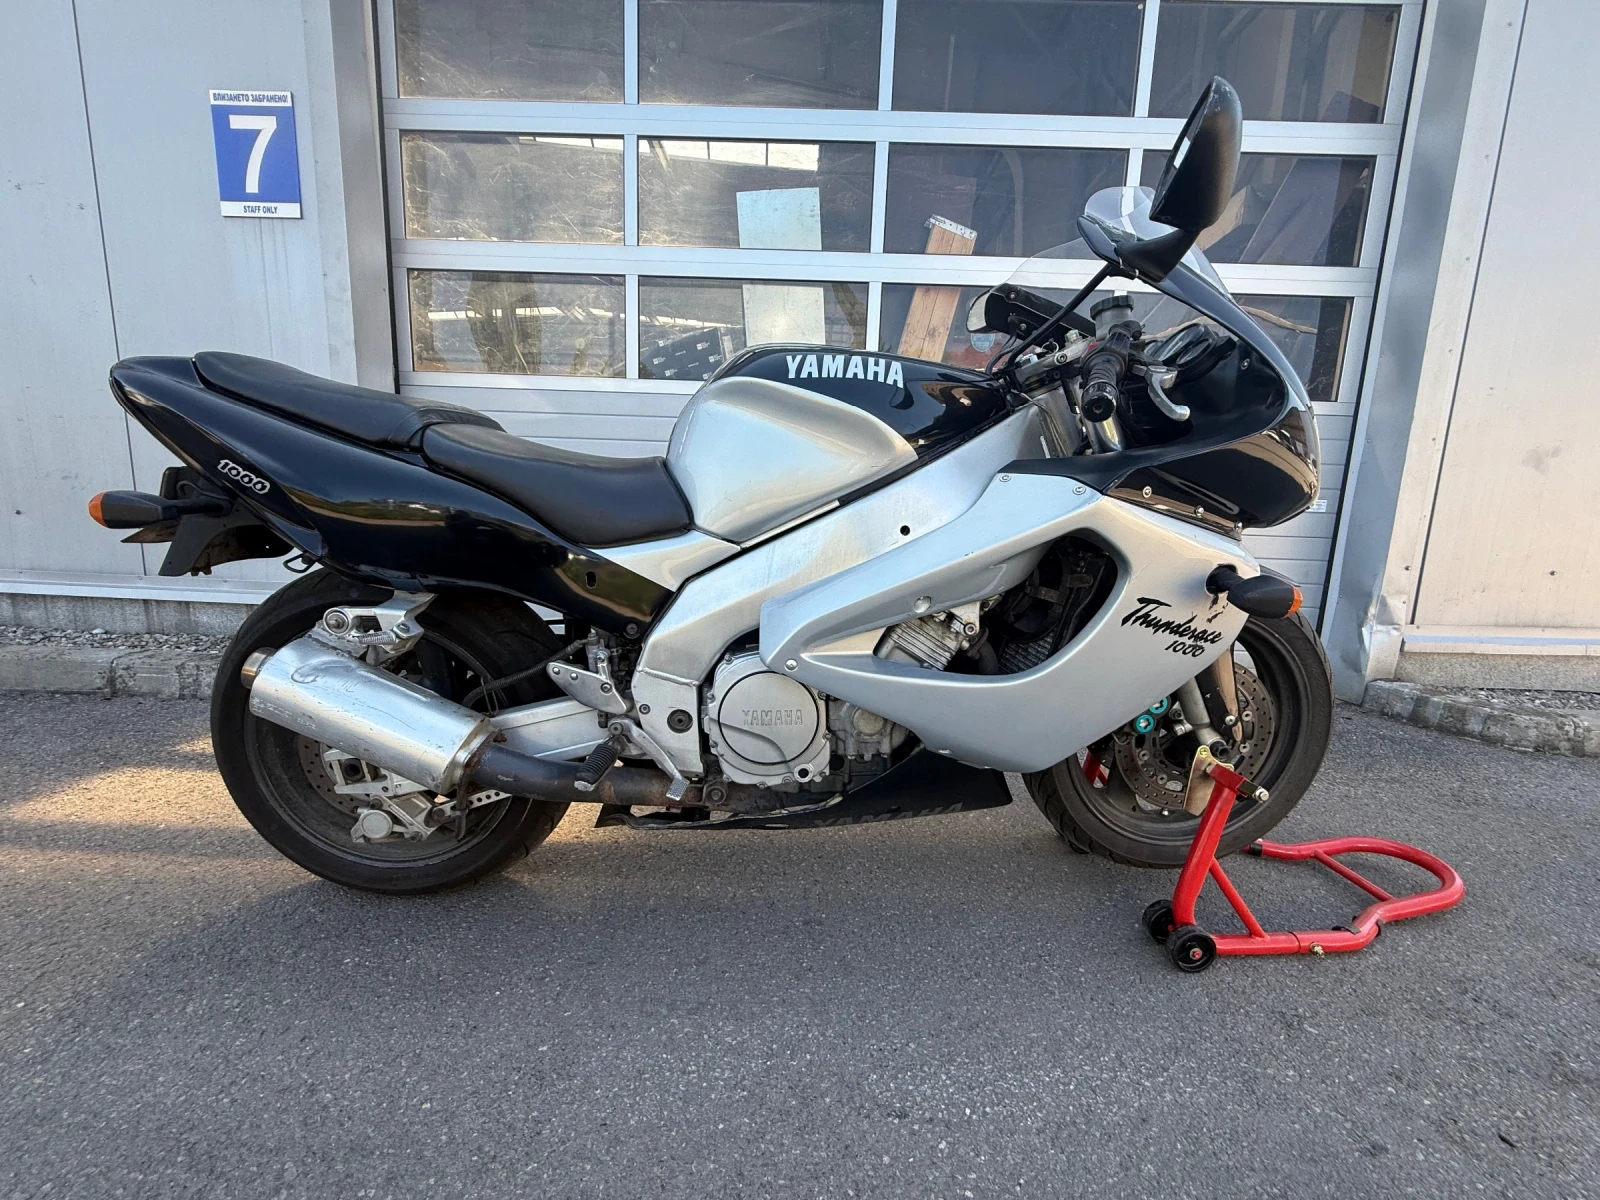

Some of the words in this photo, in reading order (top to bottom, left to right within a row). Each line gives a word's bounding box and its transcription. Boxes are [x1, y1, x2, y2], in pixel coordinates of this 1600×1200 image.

[212, 92, 250, 103] ВЛИЗАНЕТО
[251, 93, 289, 103] ЗАБРАНЕНО!
[228, 114, 277, 193] 7
[243, 205, 261, 214] STAFF
[262, 205, 278, 214] ONLY
[785, 354, 904, 389] YAMAHA
[216, 459, 270, 494] 1000
[1121, 597, 1223, 644] Thunderace
[1164, 640, 1206, 658] 1000
[741, 709, 804, 727] YAMAHA
